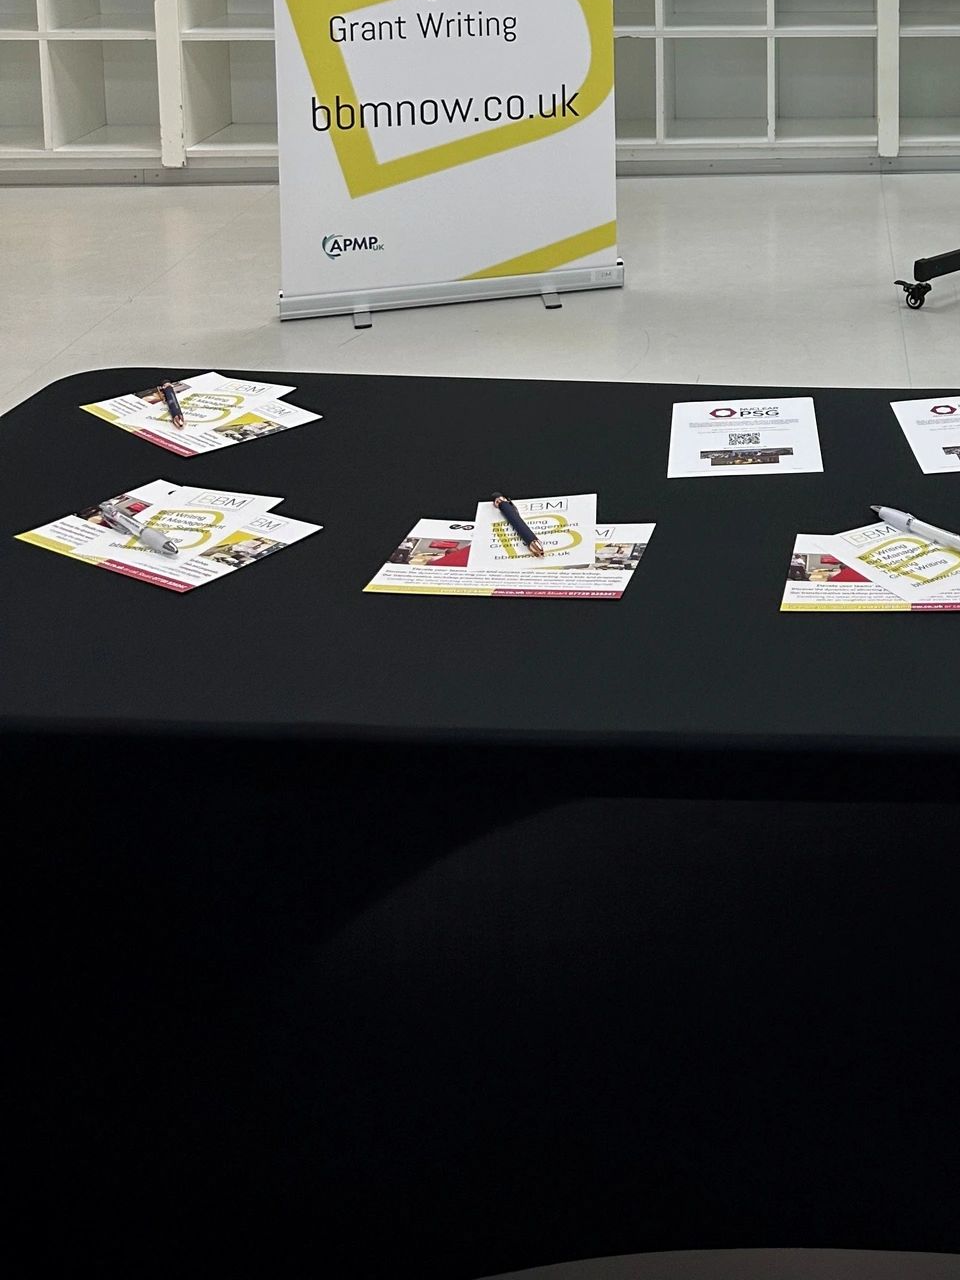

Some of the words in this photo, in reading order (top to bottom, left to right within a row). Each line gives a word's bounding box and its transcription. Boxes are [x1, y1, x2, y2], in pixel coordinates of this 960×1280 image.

[329, 16, 407, 42] Grant
[417, 12, 517, 42] Writing
[311, 84, 580, 132] bbmnow.co.uk
[330, 237, 378, 253] APMP
[199, 494, 247, 508] BBM
[850, 526, 897, 541] BBM
